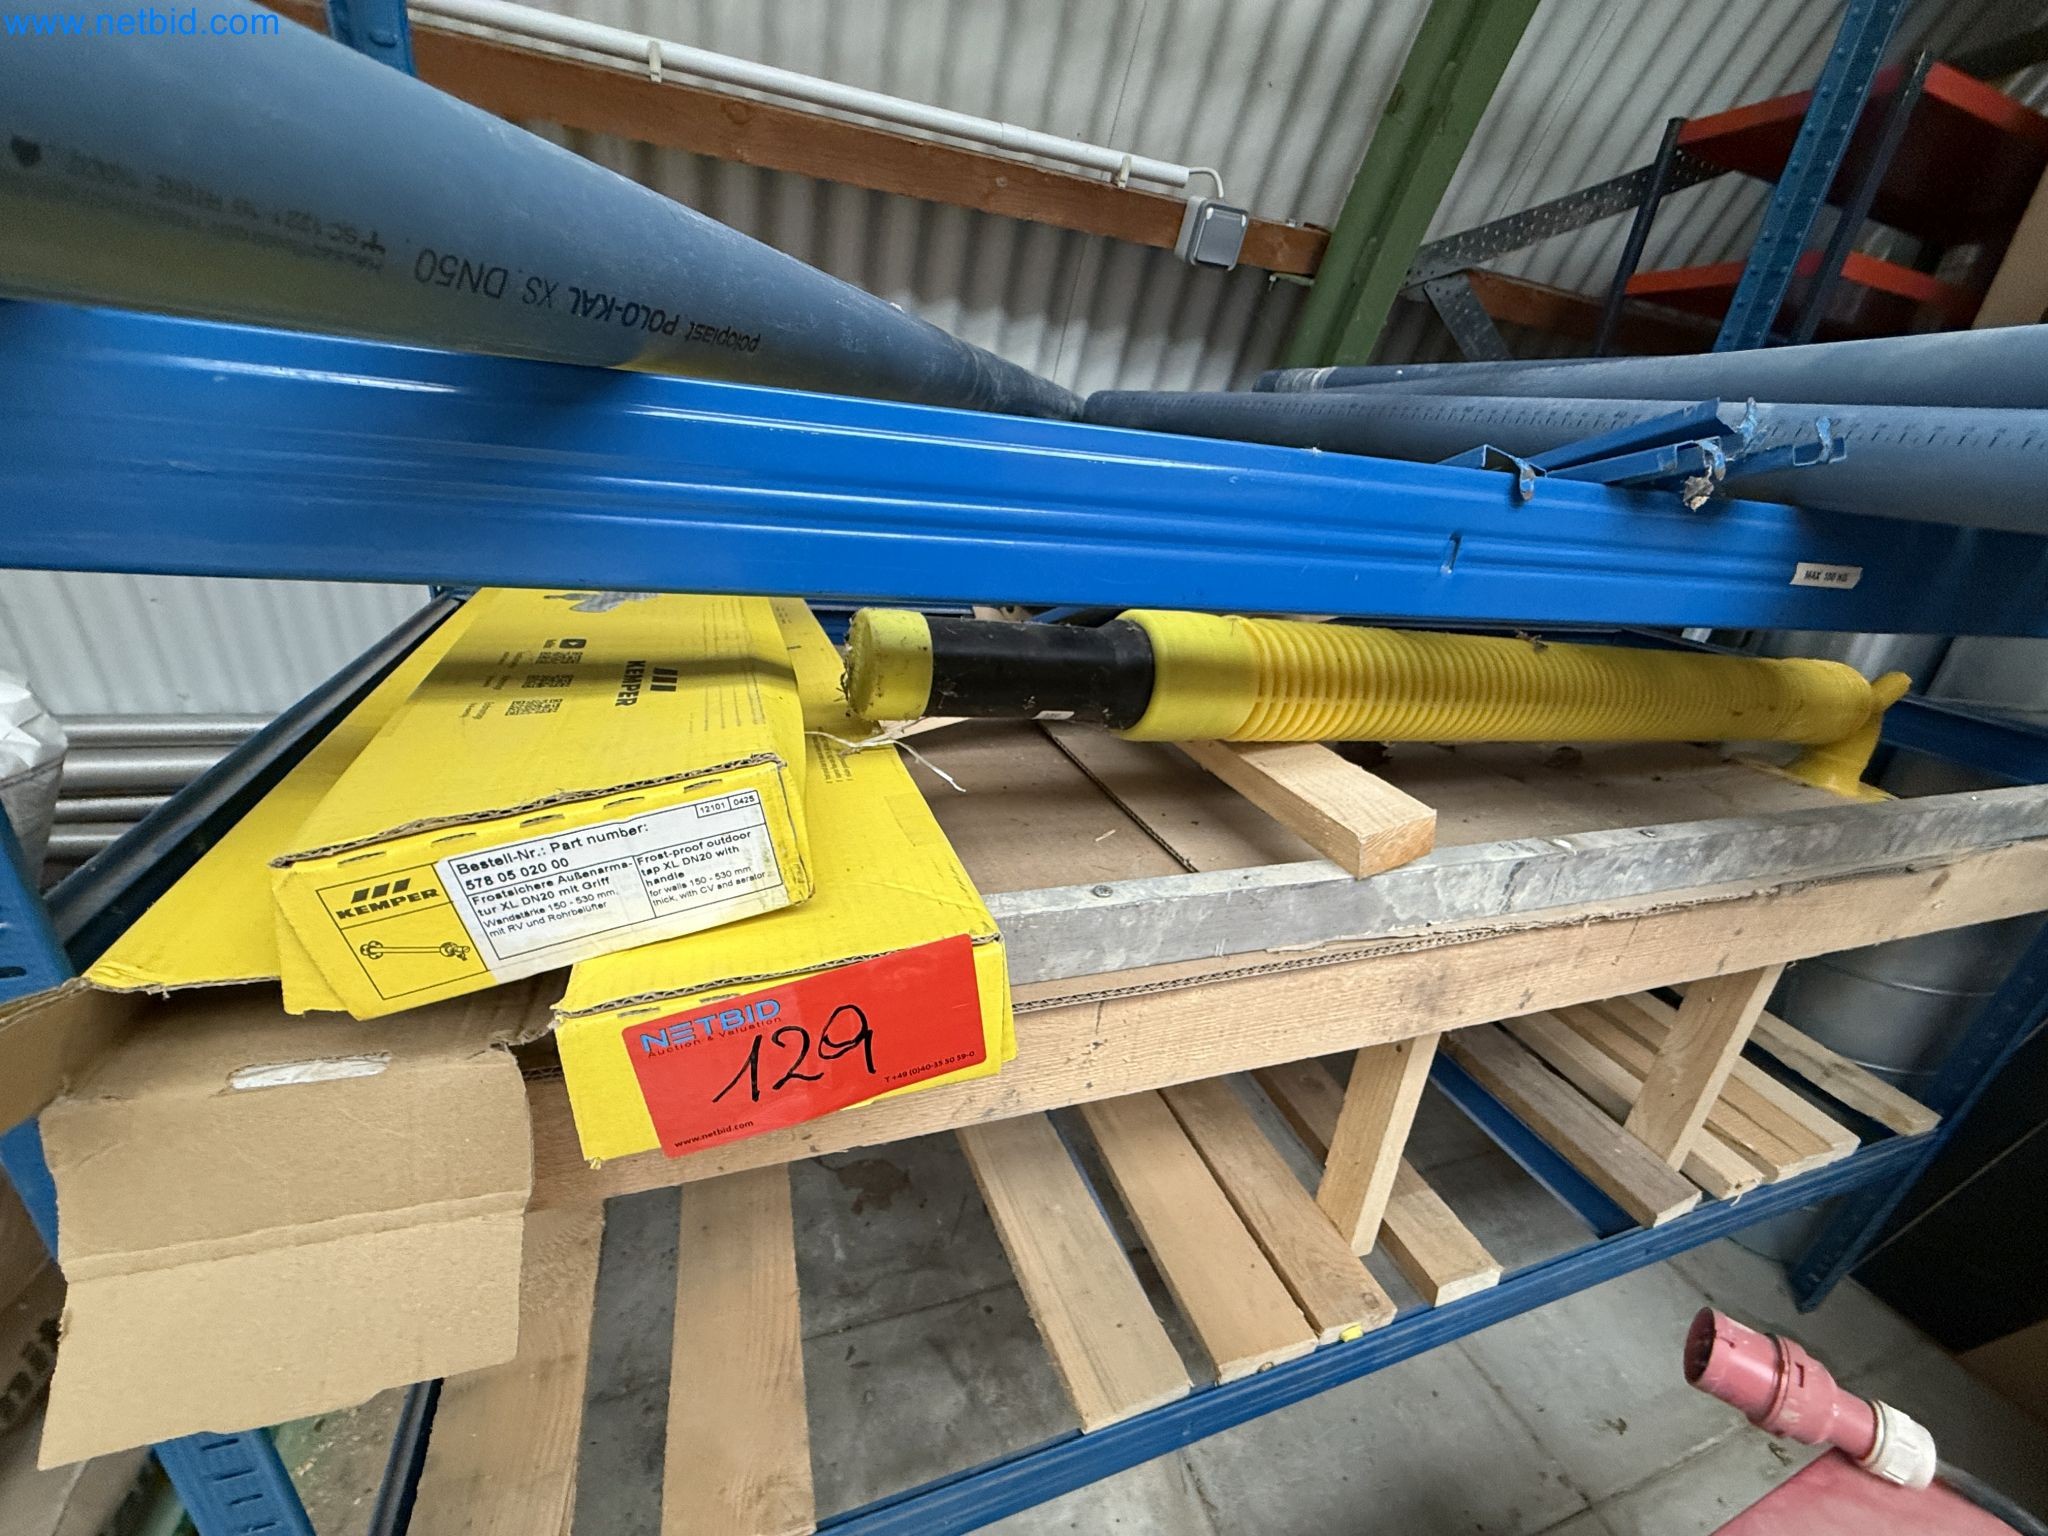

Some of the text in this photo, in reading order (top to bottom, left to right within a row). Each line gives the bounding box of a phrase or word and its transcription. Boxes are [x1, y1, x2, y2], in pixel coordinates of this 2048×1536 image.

[414, 248, 508, 299] DN50
[568, 286, 680, 337] POLO-KAL
[684, 321, 761, 353] poloplast
[1804, 570, 1821, 580] MAX
[615, 660, 646, 706] KEMPER
[700, 803, 726, 814] 12101
[733, 795, 755, 806] 0425
[456, 823, 649, 875] Bestell-Nr.: Part number:
[637, 831, 751, 866] Frost-proof outdoor
[641, 846, 740, 877] tap XL DN20 with
[465, 857, 569, 891] 578 05 020 00
[471, 862, 633, 906] Frostsichere Außenarma-
[646, 871, 685, 887] handle
[649, 887, 662, 897] for
[664, 882, 688, 894] walls
[690, 876, 707, 888] 150
[715, 870, 732, 881] 530
[679, 889, 698, 900] with
[699, 884, 714, 895] CV
[717, 880, 734, 890] and
[736, 872, 766, 885] aerator
[336, 888, 440, 919] KEMPER
[478, 876, 610, 917] tur XL DN20 mit Griff
[483, 905, 546, 929] Wandstärke
[548, 899, 566, 911] 150
[576, 893, 595, 905] 530
[489, 901, 608, 938] mit RV und Rohrbelüfter
[640, 999, 781, 1053] NETBID
[648, 1039, 701, 1058] Auction
[719, 1017, 782, 1038] Valuation
[712, 1004, 876, 1103] 129
[674, 1119, 754, 1148] www.netbid.com
